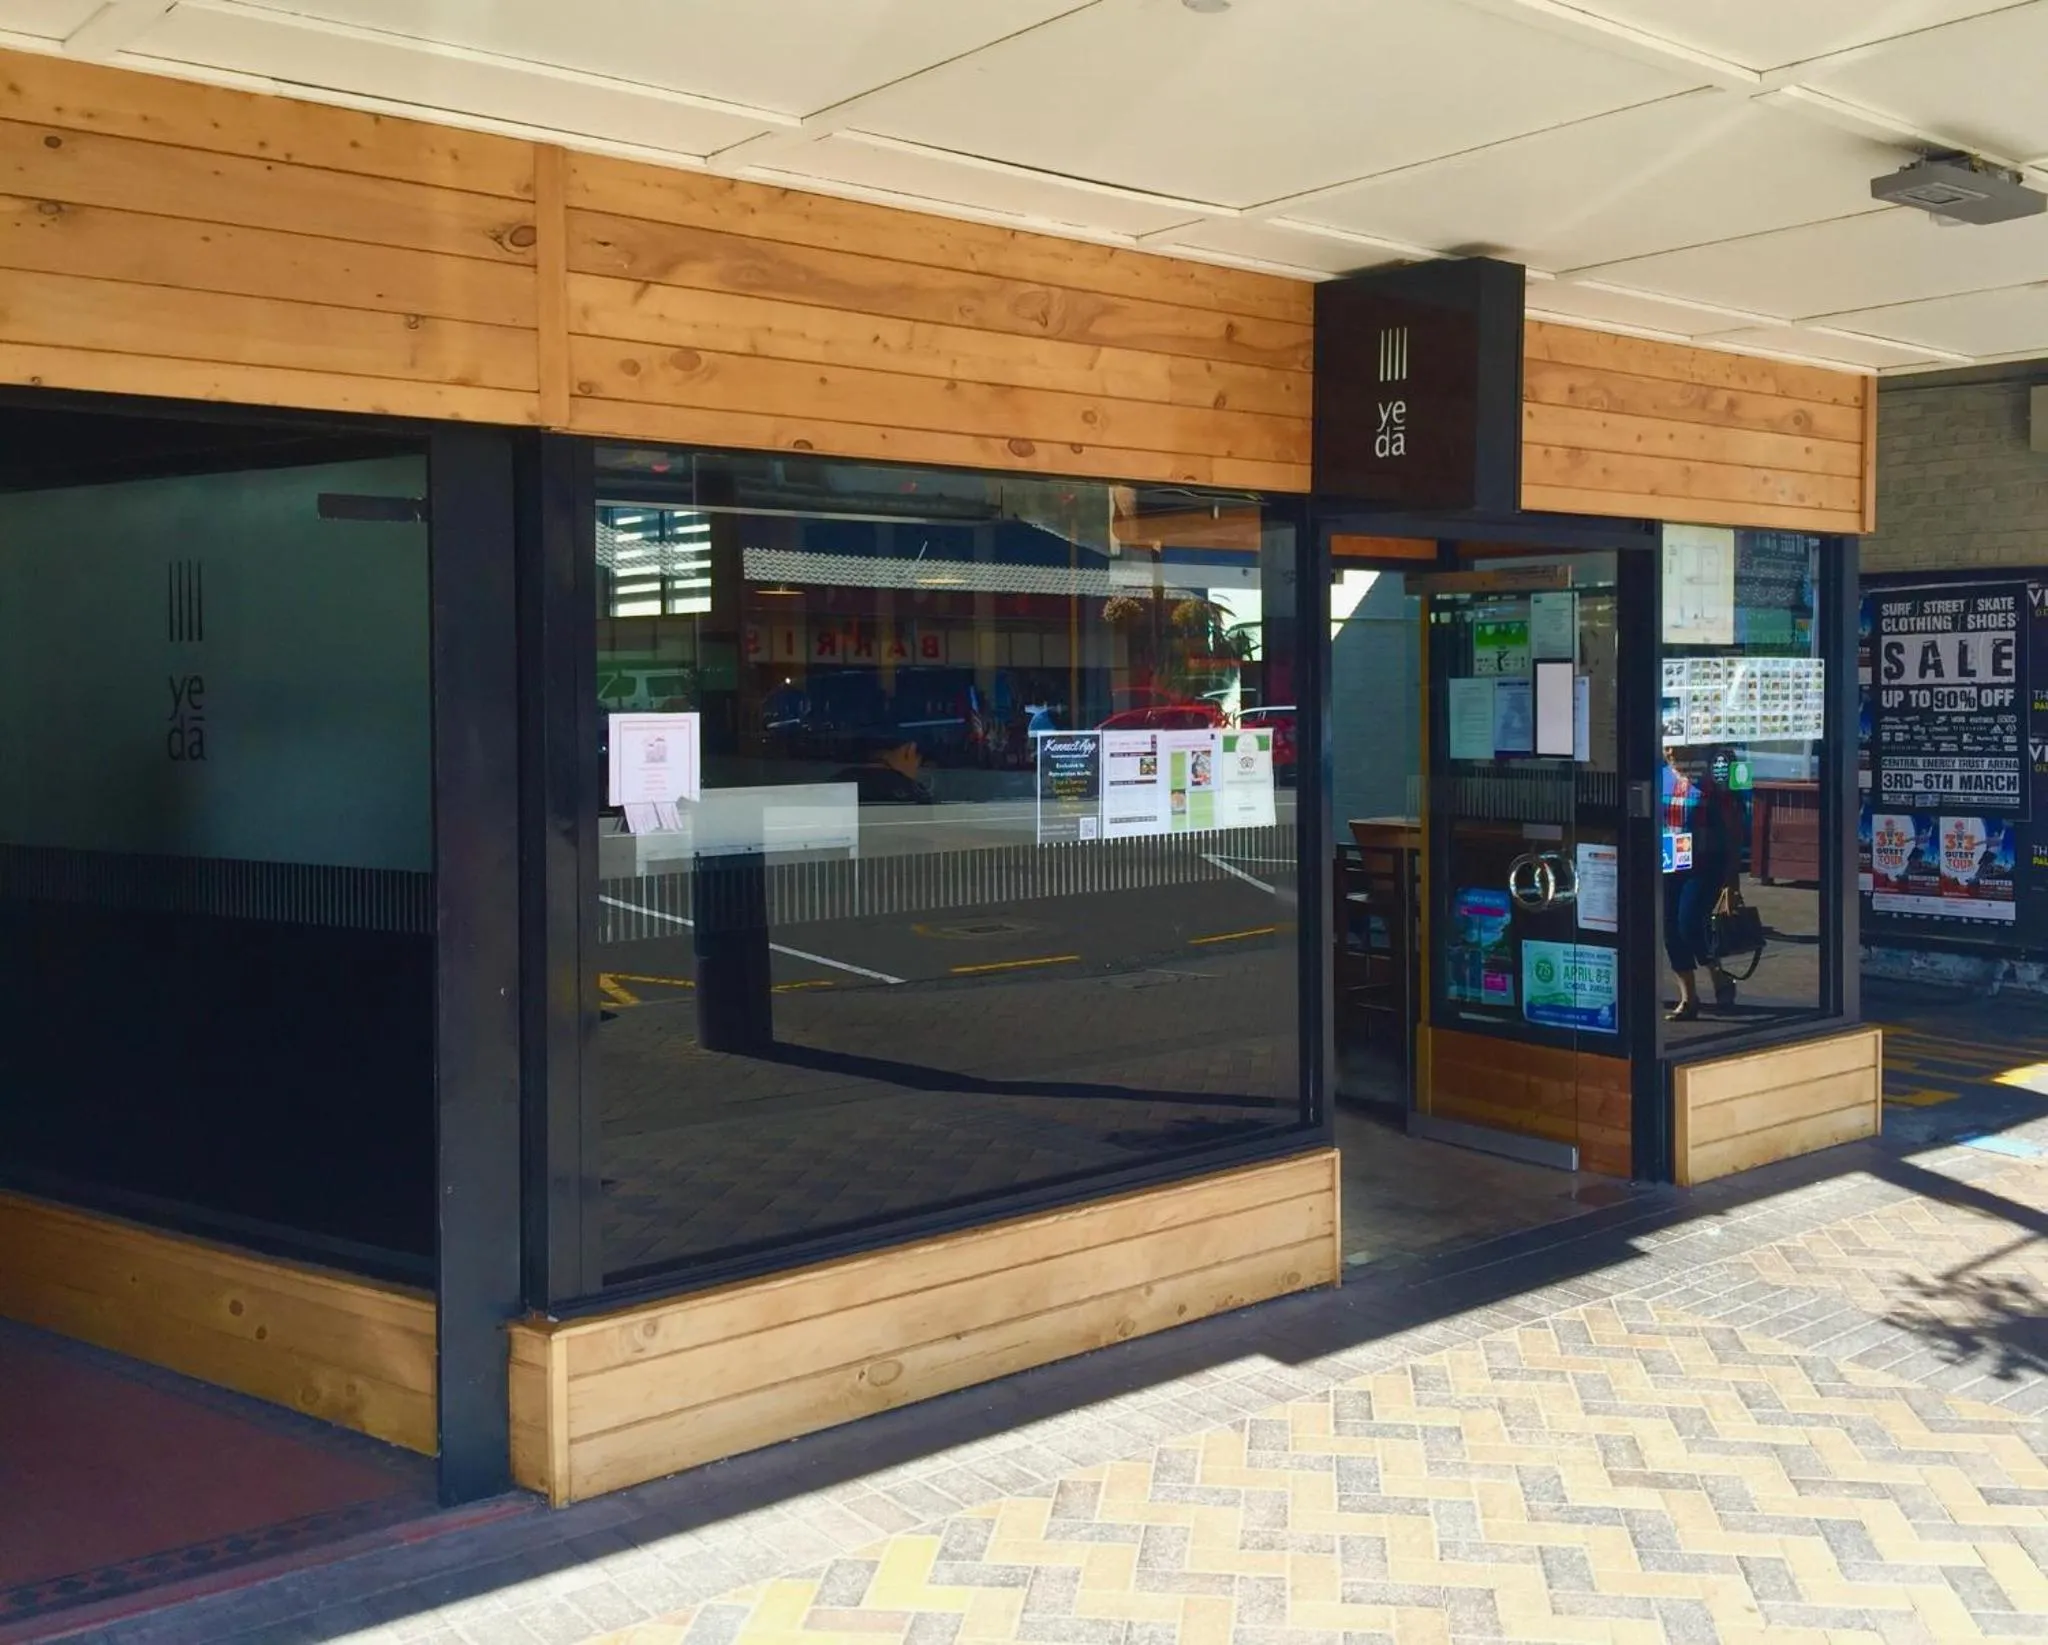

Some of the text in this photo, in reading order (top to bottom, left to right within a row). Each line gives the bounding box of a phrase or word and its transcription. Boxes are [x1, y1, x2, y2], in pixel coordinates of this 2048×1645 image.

[1376, 400, 1407, 432] ye
[1881, 596, 2015, 616] SURF STREET SKATE
[1881, 612, 2017, 632] CLOTHING SHOES
[1883, 637, 2014, 680] SALE
[167, 674, 205, 722] ye
[1881, 688, 2015, 711] UP TO 90% OFF
[1987, 759, 2019, 770] ARENA
[1883, 773, 2018, 791] 3RD-6TH MARCH
[1563, 965, 1592, 982] APRIL
